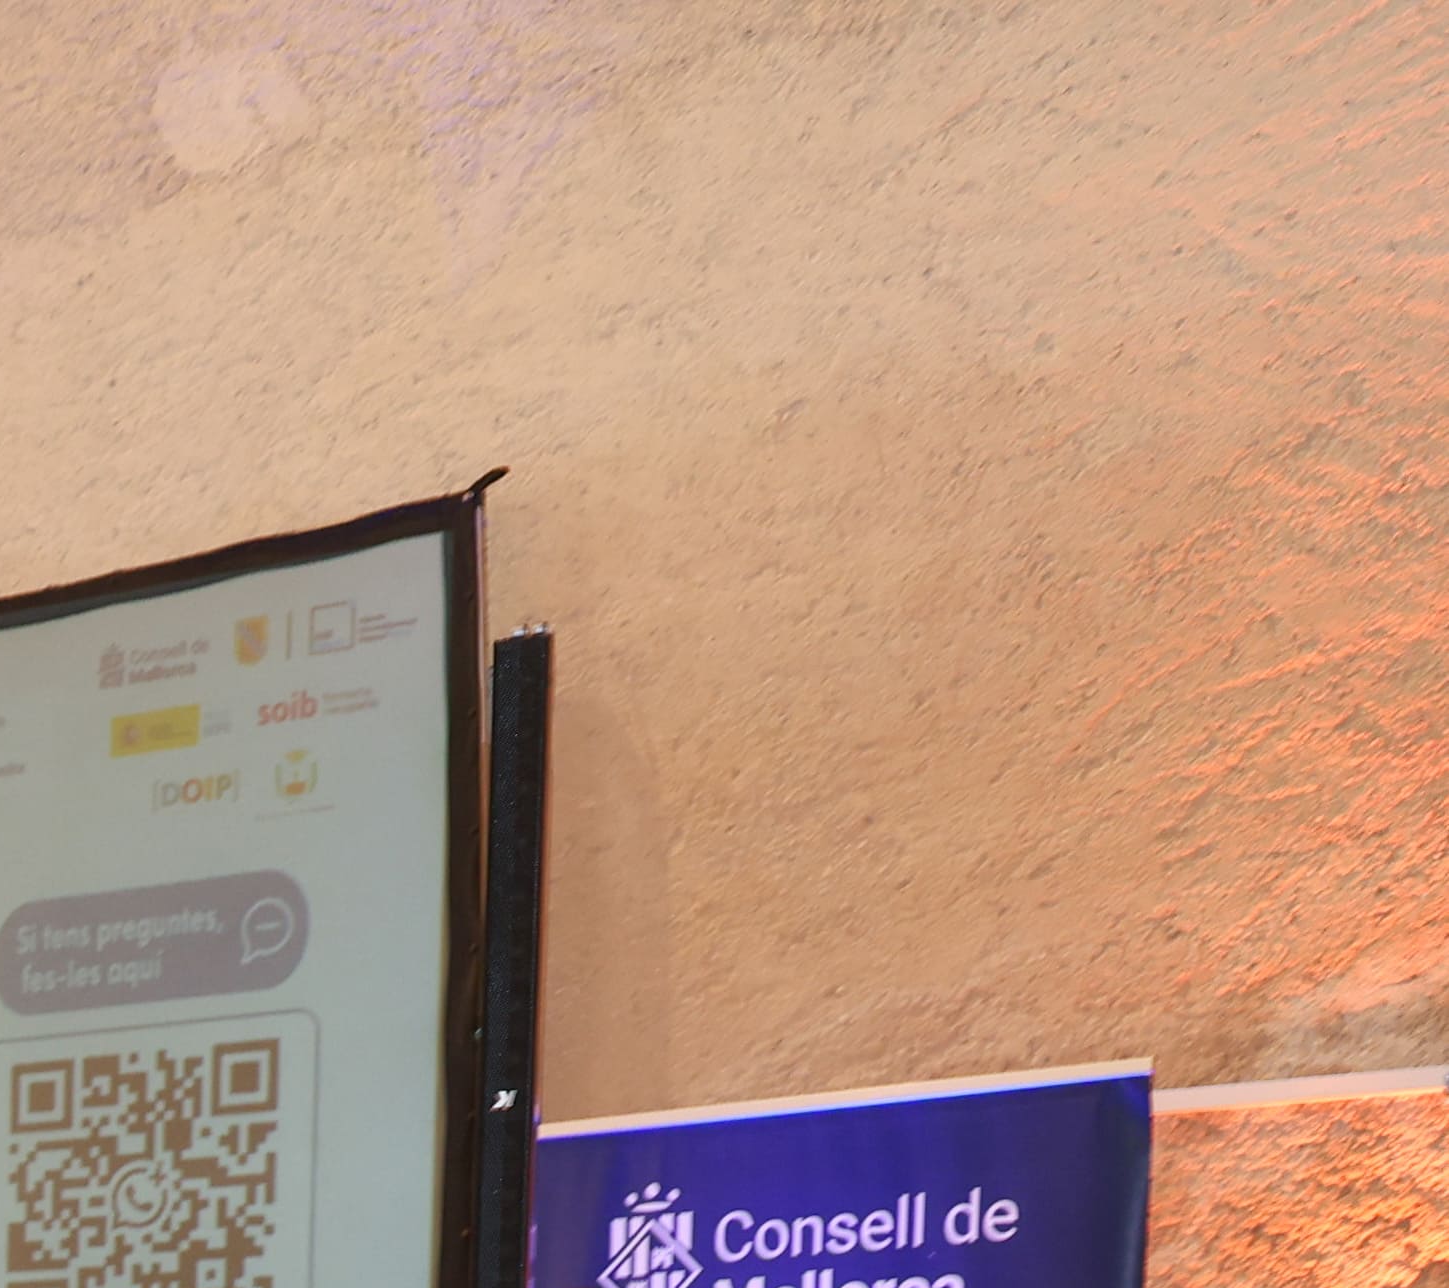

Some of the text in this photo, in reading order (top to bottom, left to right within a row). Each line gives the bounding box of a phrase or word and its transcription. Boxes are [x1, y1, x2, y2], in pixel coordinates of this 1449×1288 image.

[14, 922, 37, 955] Si
[95, 906, 225, 954] preguntes,
[714, 1187, 1020, 1263] Consell de
